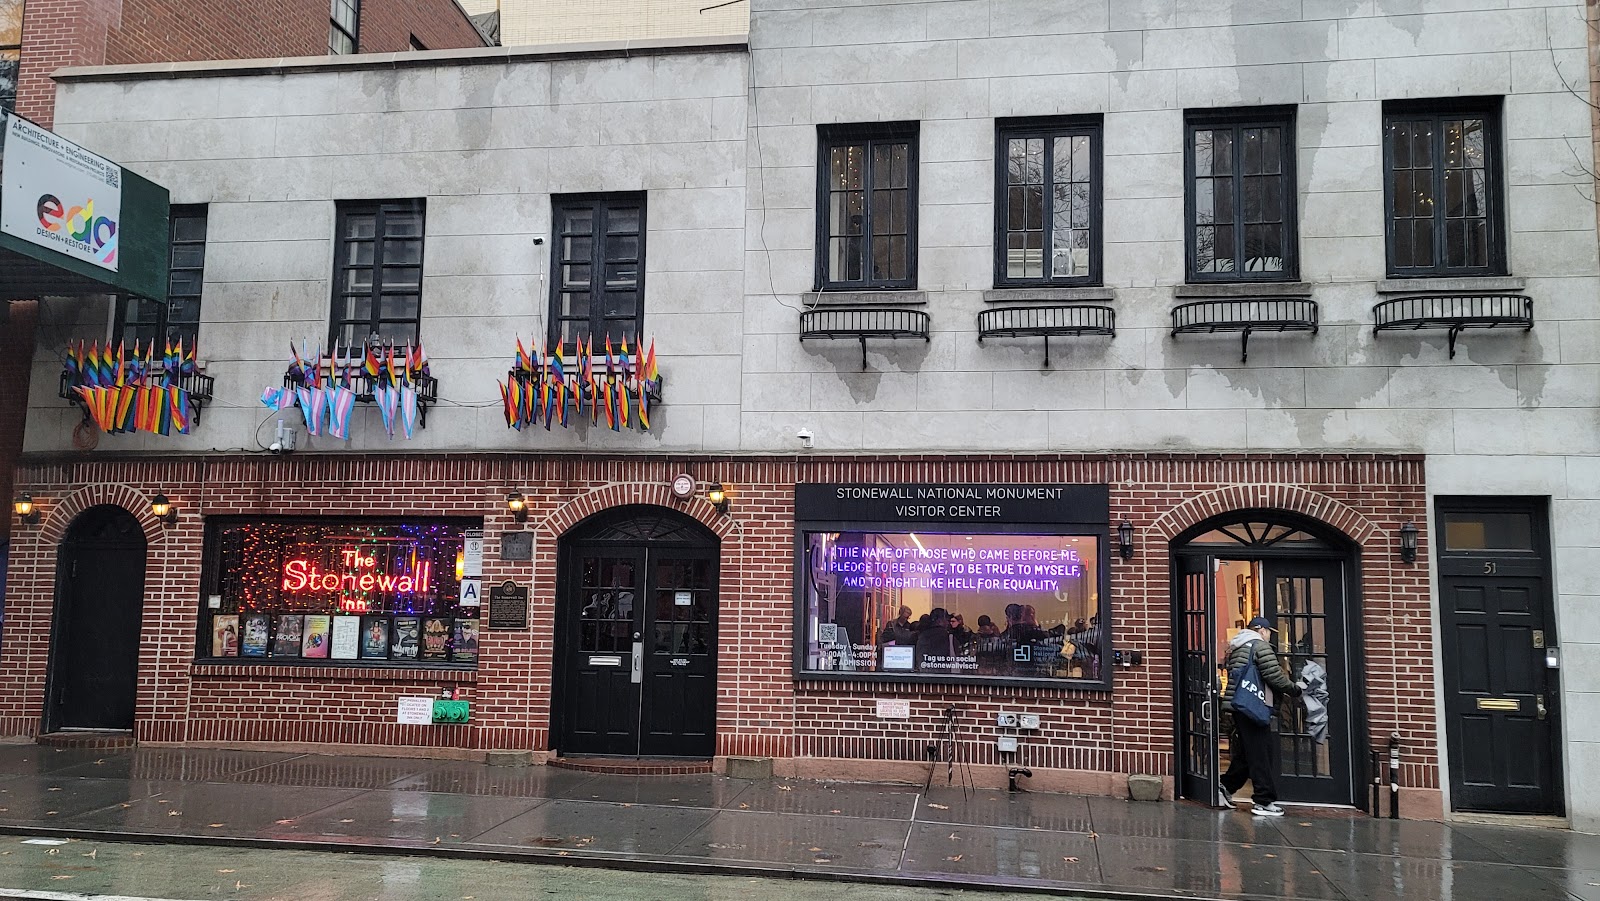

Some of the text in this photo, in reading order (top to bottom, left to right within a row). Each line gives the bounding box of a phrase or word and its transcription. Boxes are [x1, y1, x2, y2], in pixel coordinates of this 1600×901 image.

[12, 122, 60, 148] ARCHITECTURE
[66, 146, 104, 170] ENGINEERING
[836, 488, 1063, 500] STONEWALL NATIONAL MONUMENT
[896, 505, 1001, 517] VISITOR CENTER
[342, 550, 375, 568] The
[838, 547, 858, 558] THE
[862, 547, 892, 559] NAME
[896, 548, 910, 559] OF
[912, 548, 948, 559] THOSE
[950, 549, 976, 560] WHO
[979, 550, 1009, 560] CAME
[1014, 550, 1058, 560] BEFORE
[1061, 551, 1080, 562] ME,
[831, 562, 872, 572] PLEDGE
[875, 562, 888, 572] TO
[892, 563, 906, 573] BE
[910, 563, 948, 575] BRAVE,
[950, 564, 964, 574] TO
[968, 564, 982, 574] BE
[985, 564, 1014, 575] TRUE
[1017, 565, 1031, 575] TO
[1035, 565, 1080, 577] MYSELF,
[1484, 562, 1497, 574] 51
[283, 560, 430, 592] Stonewall
[844, 577, 866, 587] AND
[869, 577, 882, 587] TO
[885, 577, 918, 588] FIGHT
[920, 578, 944, 588] LIKE
[948, 578, 976, 589] HELL
[977, 578, 1000, 589] FOR
[464, 583, 476, 599] A
[342, 595, 366, 610] Inn
[853, 643, 877, 652] Sunday
[923, 654, 936, 662] Tag
